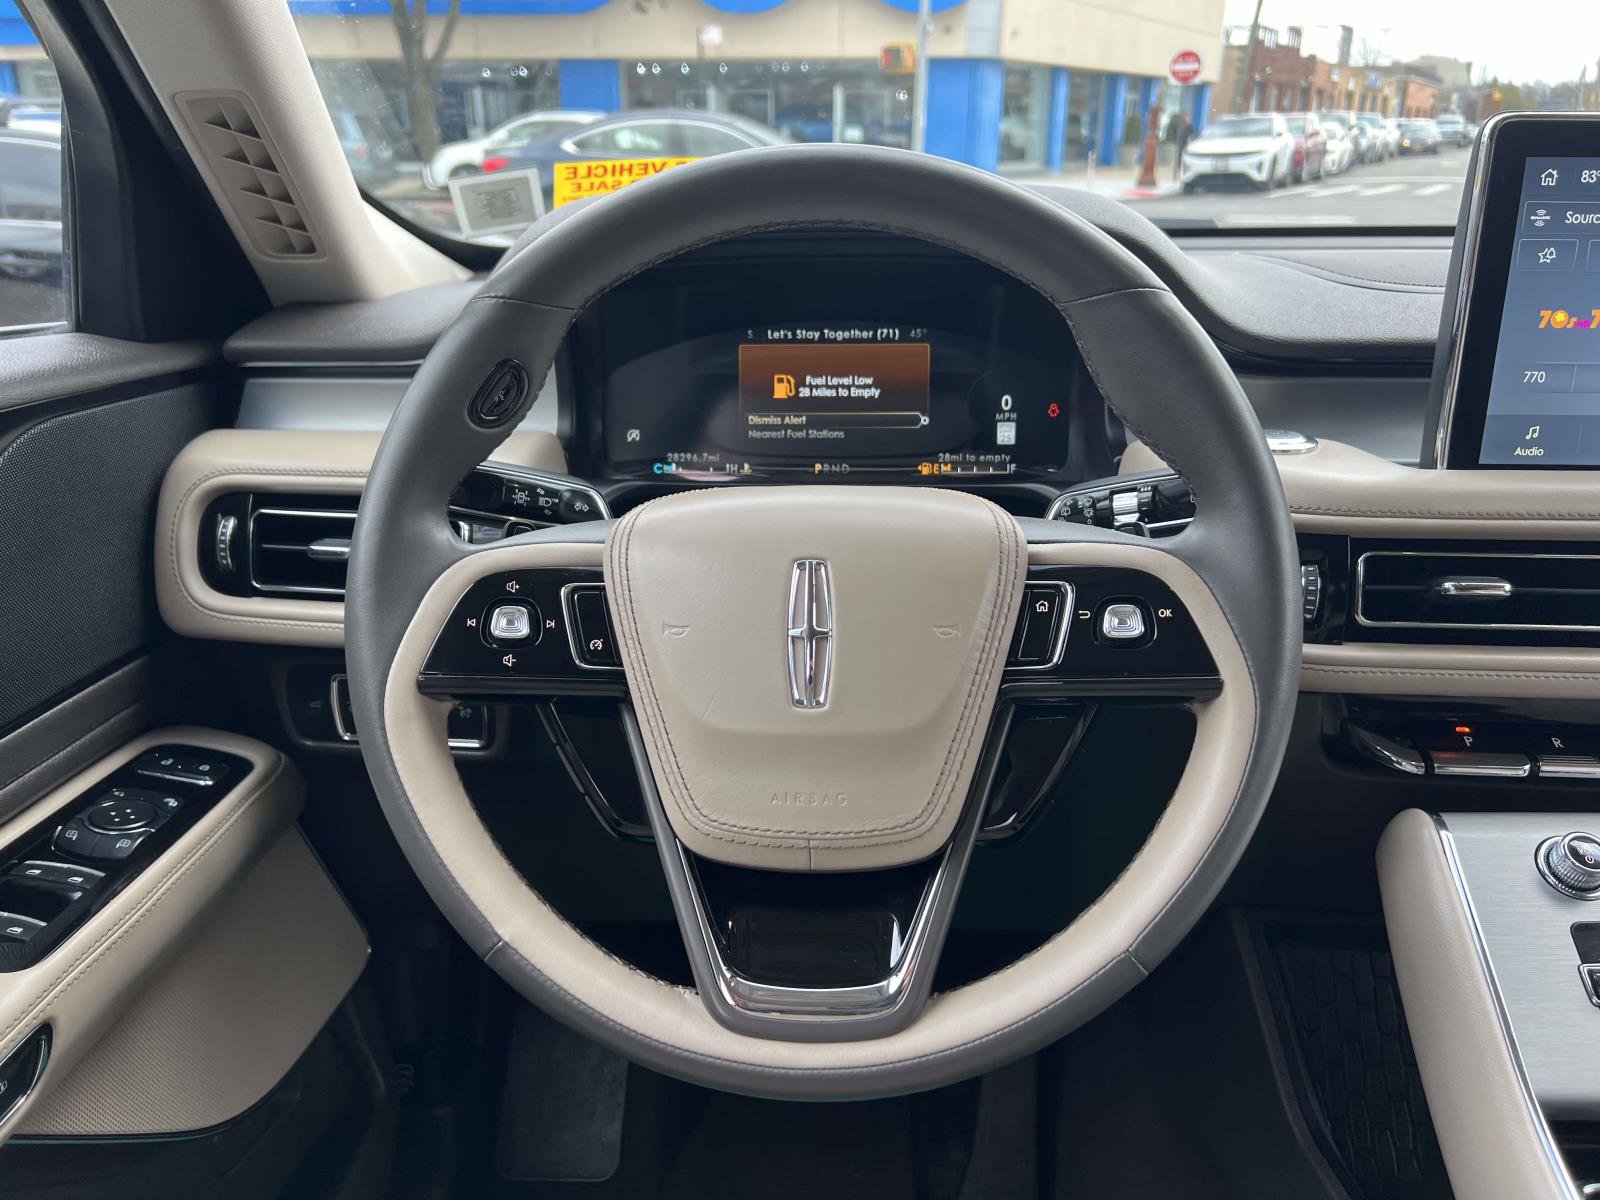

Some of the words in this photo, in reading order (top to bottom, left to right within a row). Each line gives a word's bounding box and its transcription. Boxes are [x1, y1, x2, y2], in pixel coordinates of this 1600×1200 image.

[767, 329, 793, 340] Let's
[796, 329, 820, 341] Stay
[824, 329, 873, 341] Together
[877, 329, 900, 341] (71)
[805, 375, 826, 385] Fuel
[828, 375, 852, 385] Level
[855, 375, 873, 385] Low
[1523, 371, 1546, 383] 770
[799, 387, 811, 398] 28
[812, 387, 836, 398] Miles
[838, 388, 849, 398] to
[850, 387, 881, 399] Empty
[1001, 394, 1012, 411] 0
[748, 415, 781, 425] Dismiss
[783, 415, 807, 425] Alert
[995, 412, 1017, 421] MPH
[748, 429, 785, 439] Nearest
[787, 429, 806, 439] Fuel
[808, 429, 845, 439] Stations
[1514, 446, 1544, 456] Audio
[966, 453, 975, 462] to
[979, 453, 1011, 463] empty
[1158, 608, 1173, 618] OK
[1464, 735, 1473, 747] P
[1551, 737, 1564, 748] R
[769, 791, 849, 808] AIRBAG
